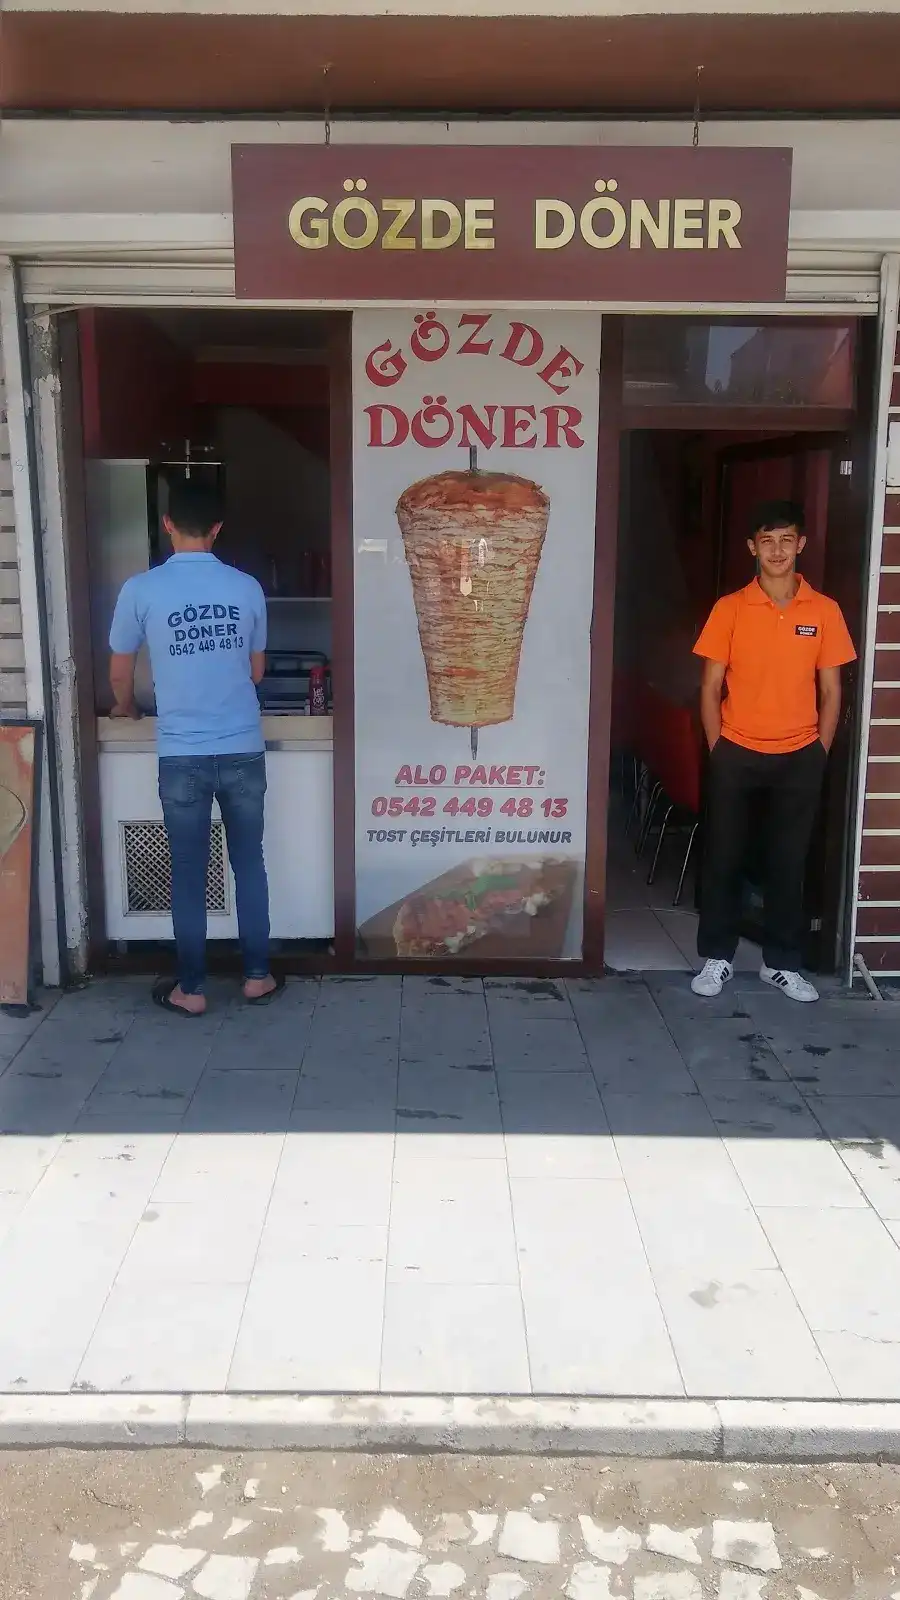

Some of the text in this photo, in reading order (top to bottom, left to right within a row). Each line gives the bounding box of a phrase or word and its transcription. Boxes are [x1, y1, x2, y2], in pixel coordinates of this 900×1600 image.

[288, 178, 743, 250] GÖZDE DÖNER
[365, 310, 584, 396] GÖZDE
[363, 395, 585, 450] DÖNER
[167, 603, 241, 628] GÖZDE
[174, 623, 238, 642] DÖNER
[169, 642, 196, 656] 0542
[198, 639, 216, 653] 449
[394, 764, 546, 786] ALO PAKET:
[371, 796, 569, 818] 0542 449 48 13
[366, 826, 572, 847] TOST ÇEŞİTLERİ BULUNUR
